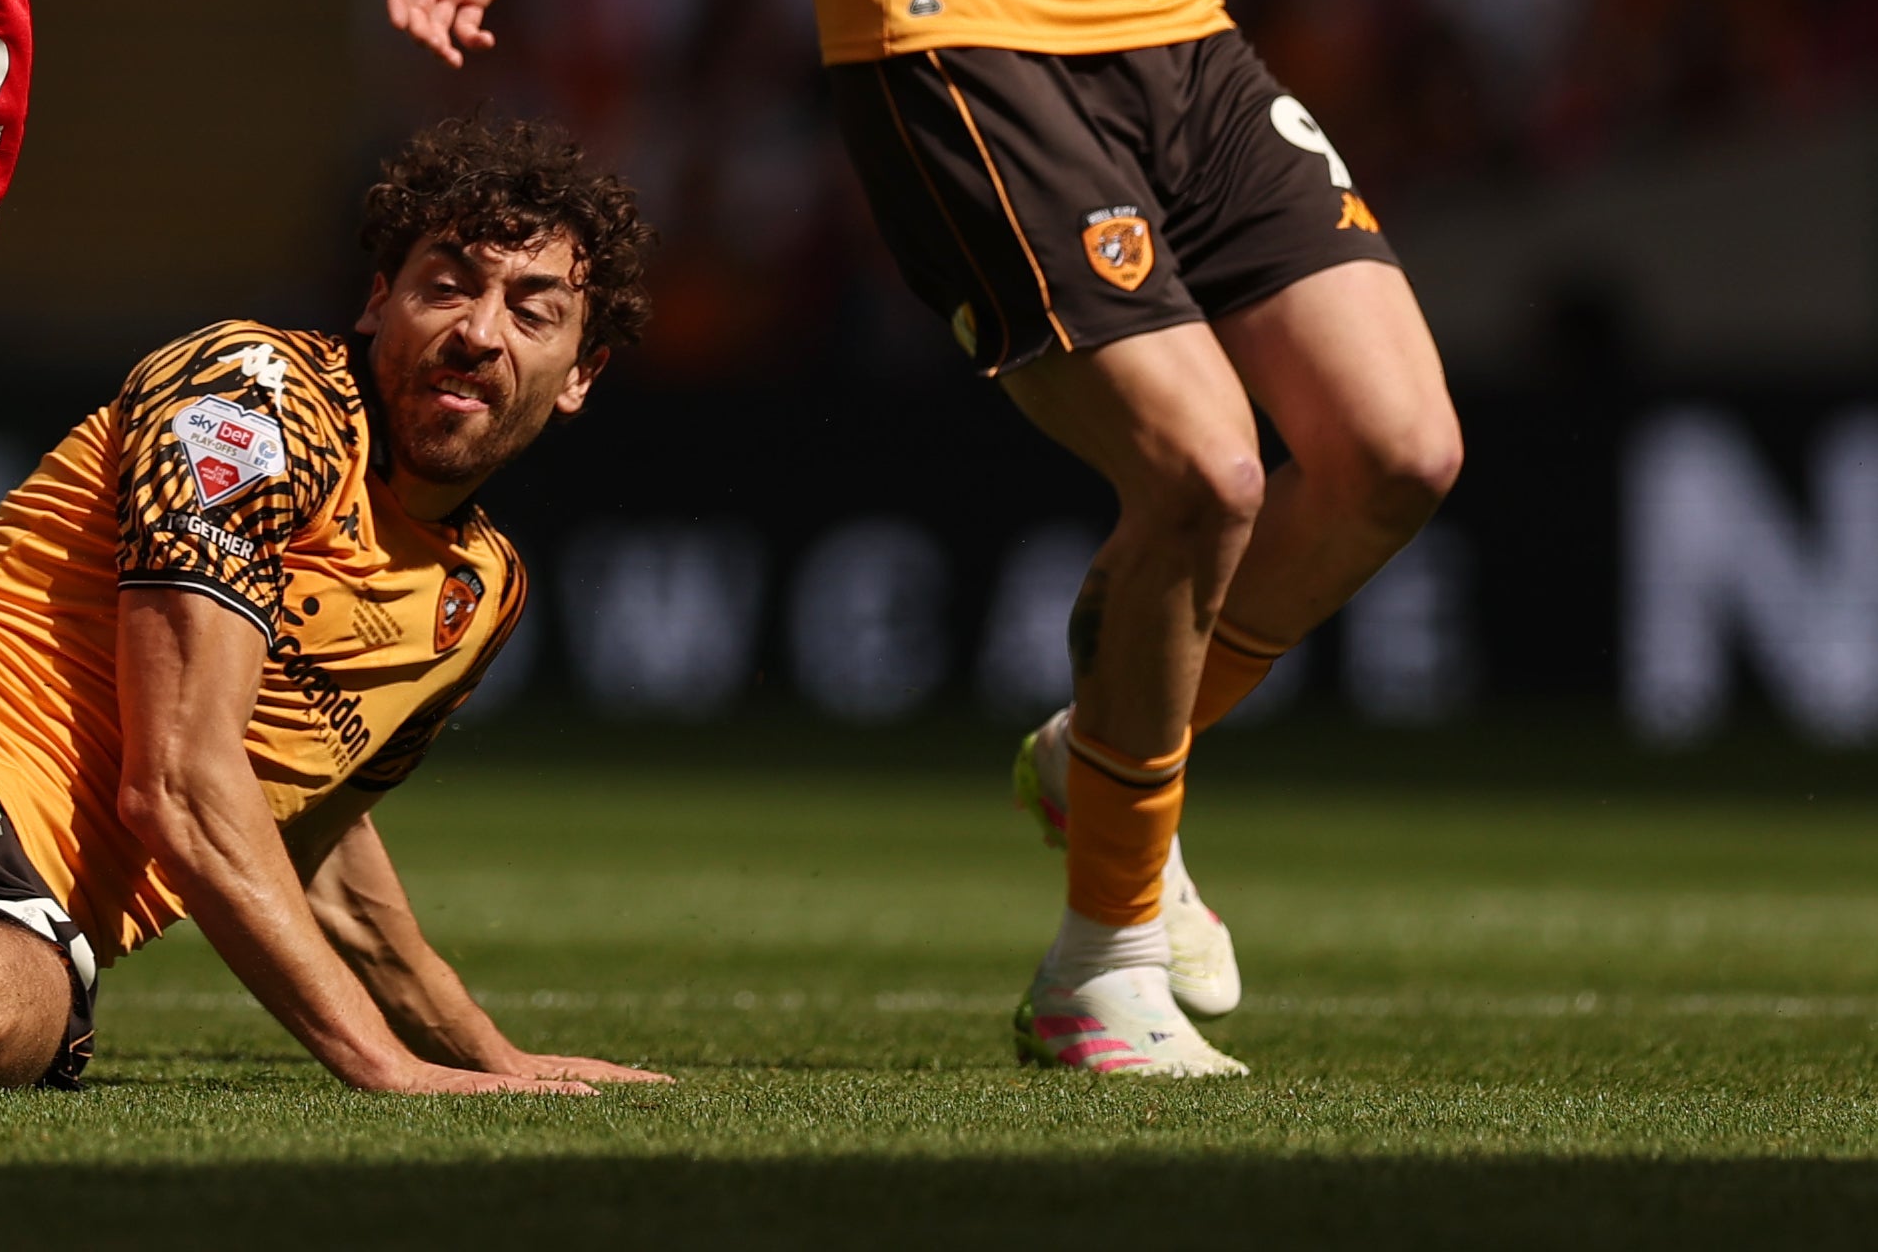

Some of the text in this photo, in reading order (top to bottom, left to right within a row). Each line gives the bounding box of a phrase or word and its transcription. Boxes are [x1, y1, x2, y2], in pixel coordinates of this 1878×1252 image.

[1270, 95, 1353, 189] 9
[188, 413, 218, 434] sky
[220, 423, 250, 445] bet
[190, 432, 238, 457] PLAY-OFFS
[253, 456, 270, 470] EFL
[166, 512, 255, 560] TOGETHER
